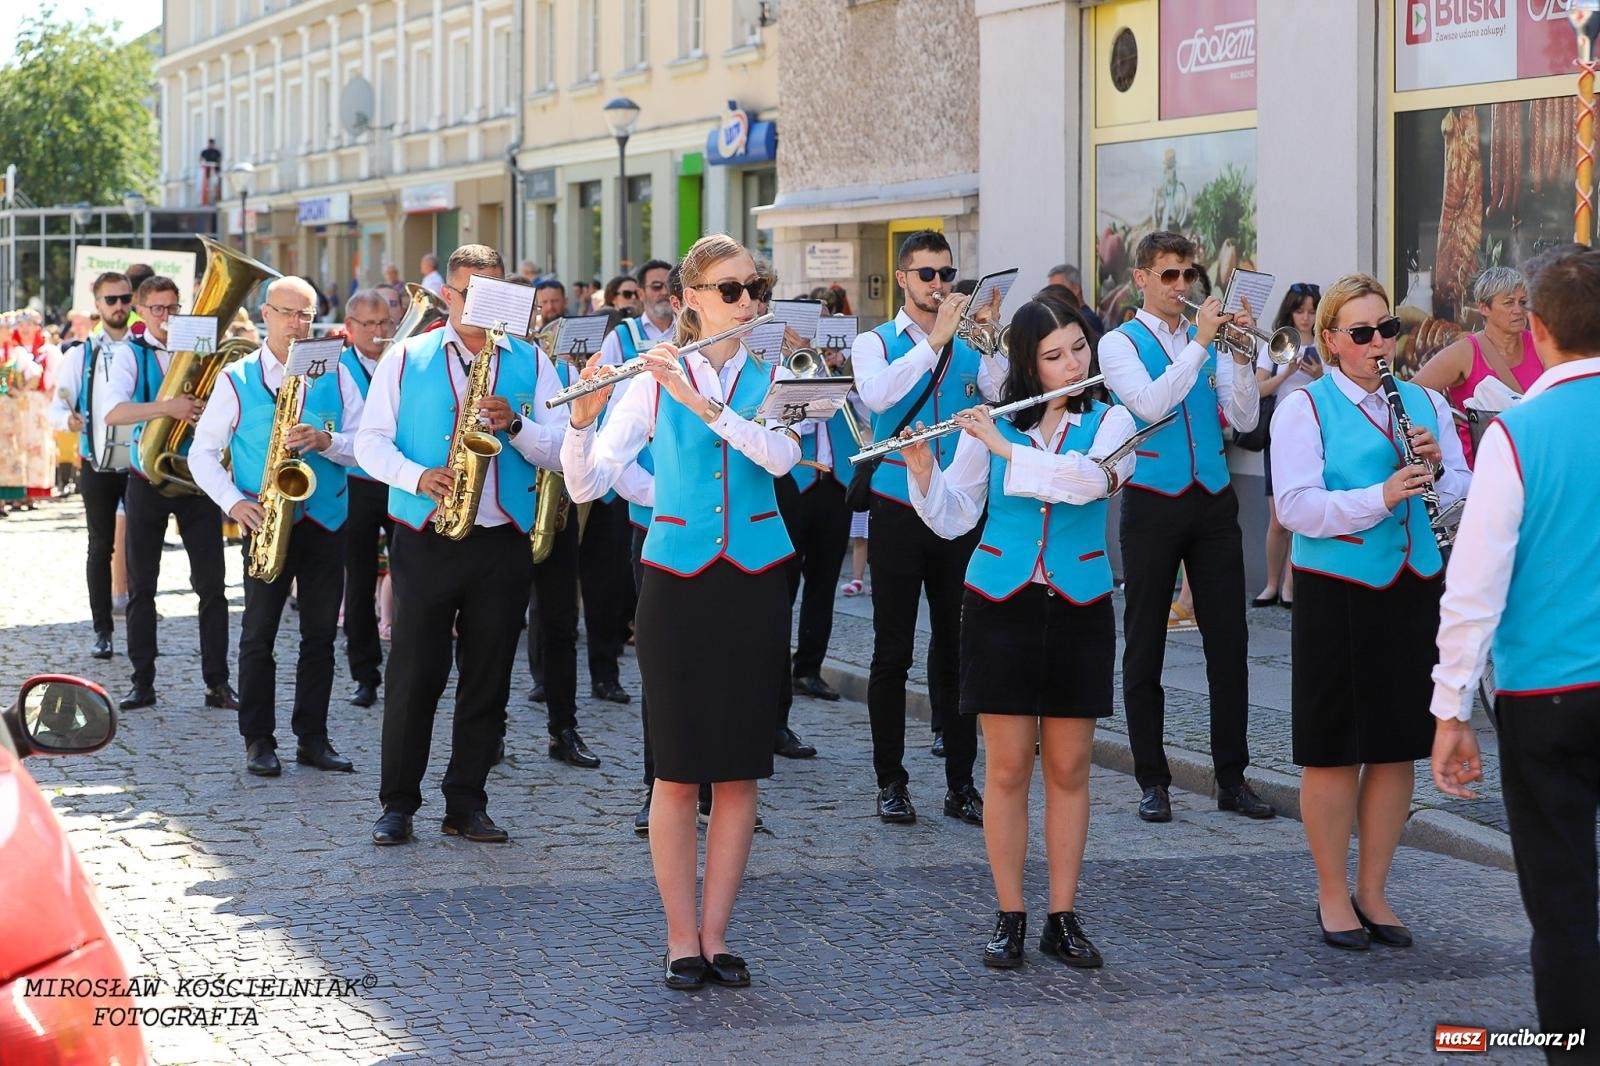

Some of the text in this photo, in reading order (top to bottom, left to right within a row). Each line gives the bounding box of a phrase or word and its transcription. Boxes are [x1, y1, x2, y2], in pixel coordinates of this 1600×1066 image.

[1435, 0, 1506, 27] Bliski
[1435, 24, 1507, 42] Zawsze udane zakupy!
